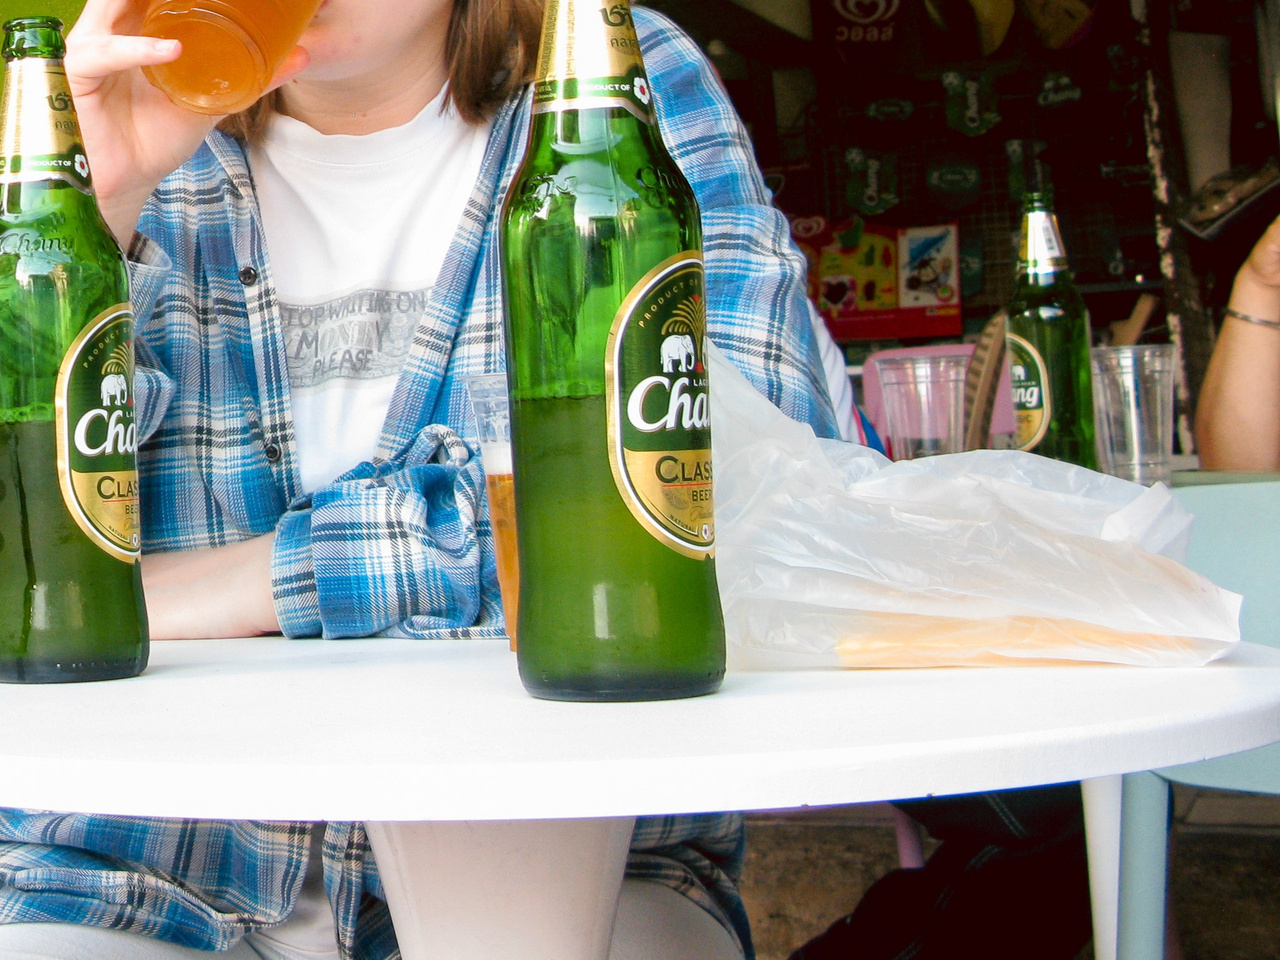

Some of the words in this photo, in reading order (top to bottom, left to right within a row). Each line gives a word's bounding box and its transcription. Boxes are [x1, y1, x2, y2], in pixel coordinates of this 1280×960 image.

[620, 83, 631, 91] OF
[28, 159, 62, 167] RODUCT
[63, 159, 72, 168] OF
[638, 281, 685, 328] PRODUCT
[83, 329, 119, 369] PRODUCT
